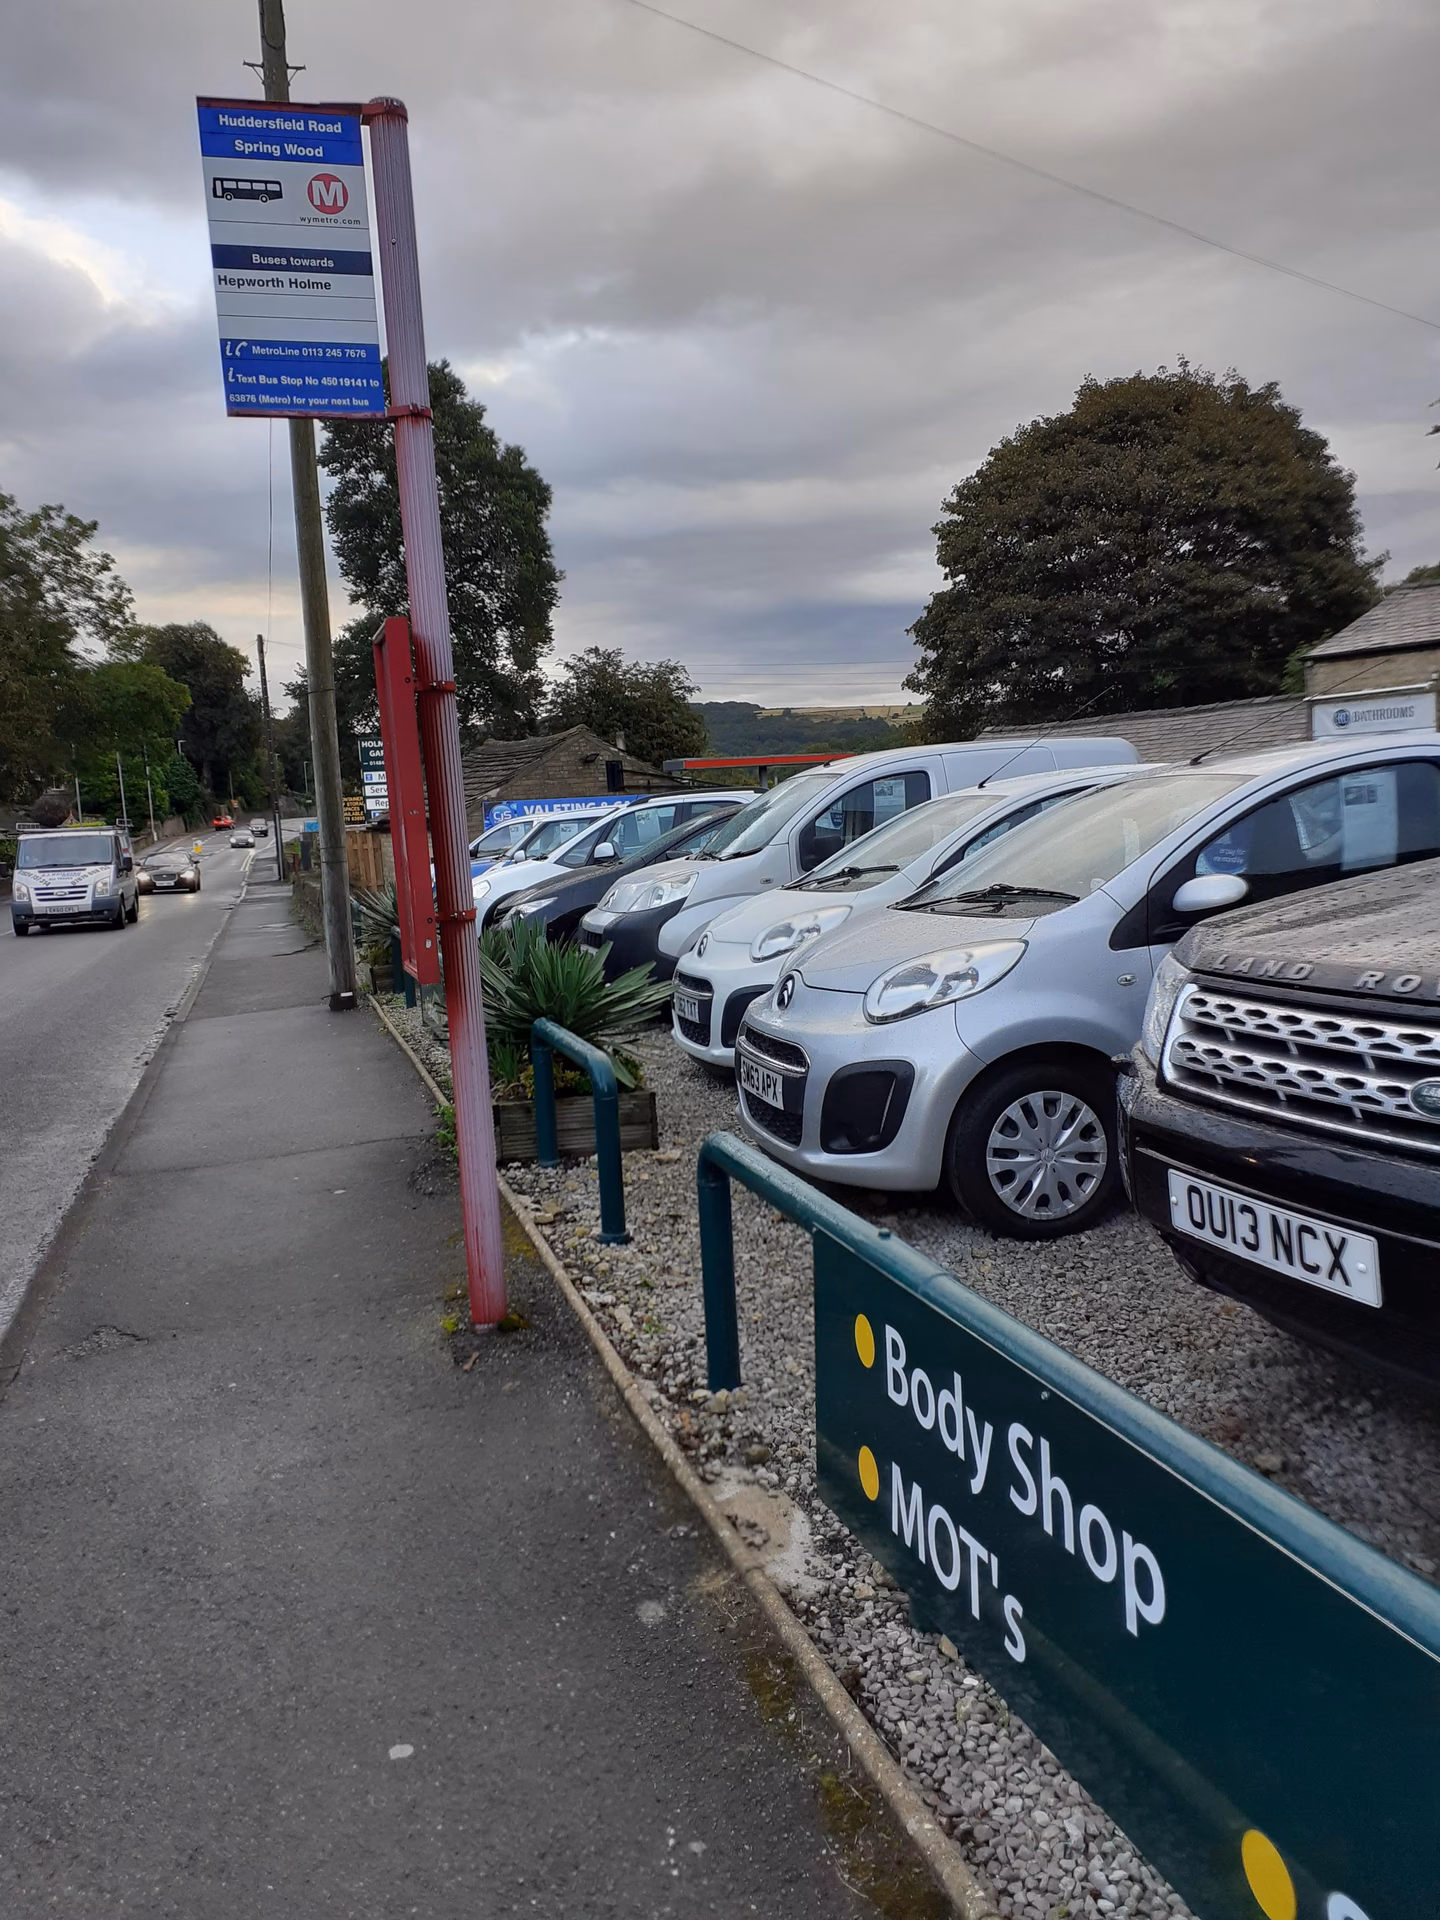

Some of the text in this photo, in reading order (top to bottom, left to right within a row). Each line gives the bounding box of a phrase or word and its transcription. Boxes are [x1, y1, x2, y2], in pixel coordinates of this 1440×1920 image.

[218, 114, 342, 133] Huddersfield Road
[234, 139, 323, 157] Spring Wood
[311, 180, 345, 207] M
[299, 216, 361, 225] wymetro.com
[251, 254, 335, 268] Buses towards
[217, 275, 332, 290] Hepworth Holme
[252, 345, 300, 356] MetroLine
[302, 347, 323, 357] 0113
[325, 348, 342, 357] 245
[345, 349, 367, 358] 7676
[236, 374, 257, 384] Text
[259, 374, 278, 384] Bus
[280, 375, 303, 387] Stop
[305, 376, 319, 386] No
[369, 378, 380, 387] to
[229, 393, 369, 406] 63876 (Metro) for your next bus
[1353, 705, 1415, 722] BATHROOMS
[1211, 954, 1440, 997] LAND RO
[762, 1071, 778, 1103] APX
[1270, 1212, 1352, 1288] NCX
[885, 1323, 1167, 1638] Body Shop
[890, 1461, 1027, 1663] MOT's
